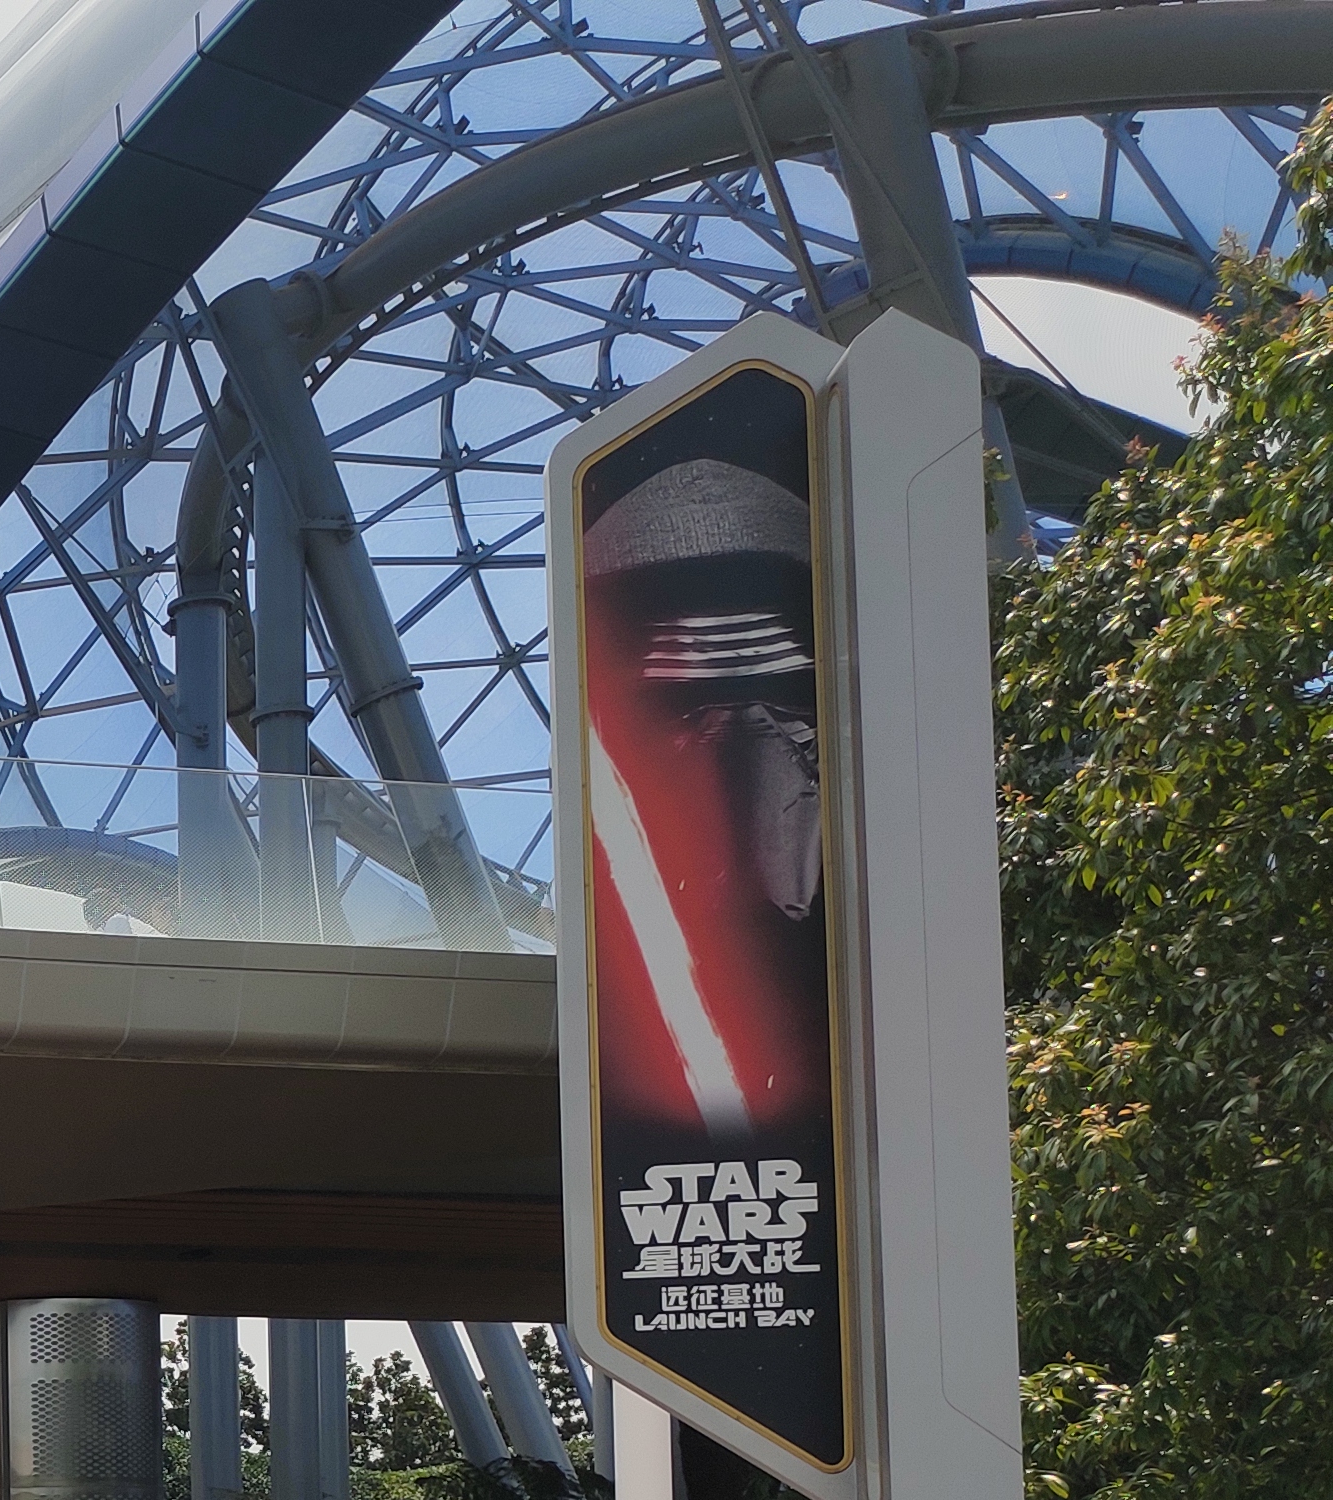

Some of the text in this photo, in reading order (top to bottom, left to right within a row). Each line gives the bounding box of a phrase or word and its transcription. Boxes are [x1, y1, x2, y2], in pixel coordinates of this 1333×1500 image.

[620, 1159, 818, 1205] STAR
[620, 1199, 819, 1244] WARS
[622, 1240, 821, 1279] 星球大战
[660, 1282, 784, 1311] 远征基地
[634, 1309, 815, 1331] LAUNCH BAY
